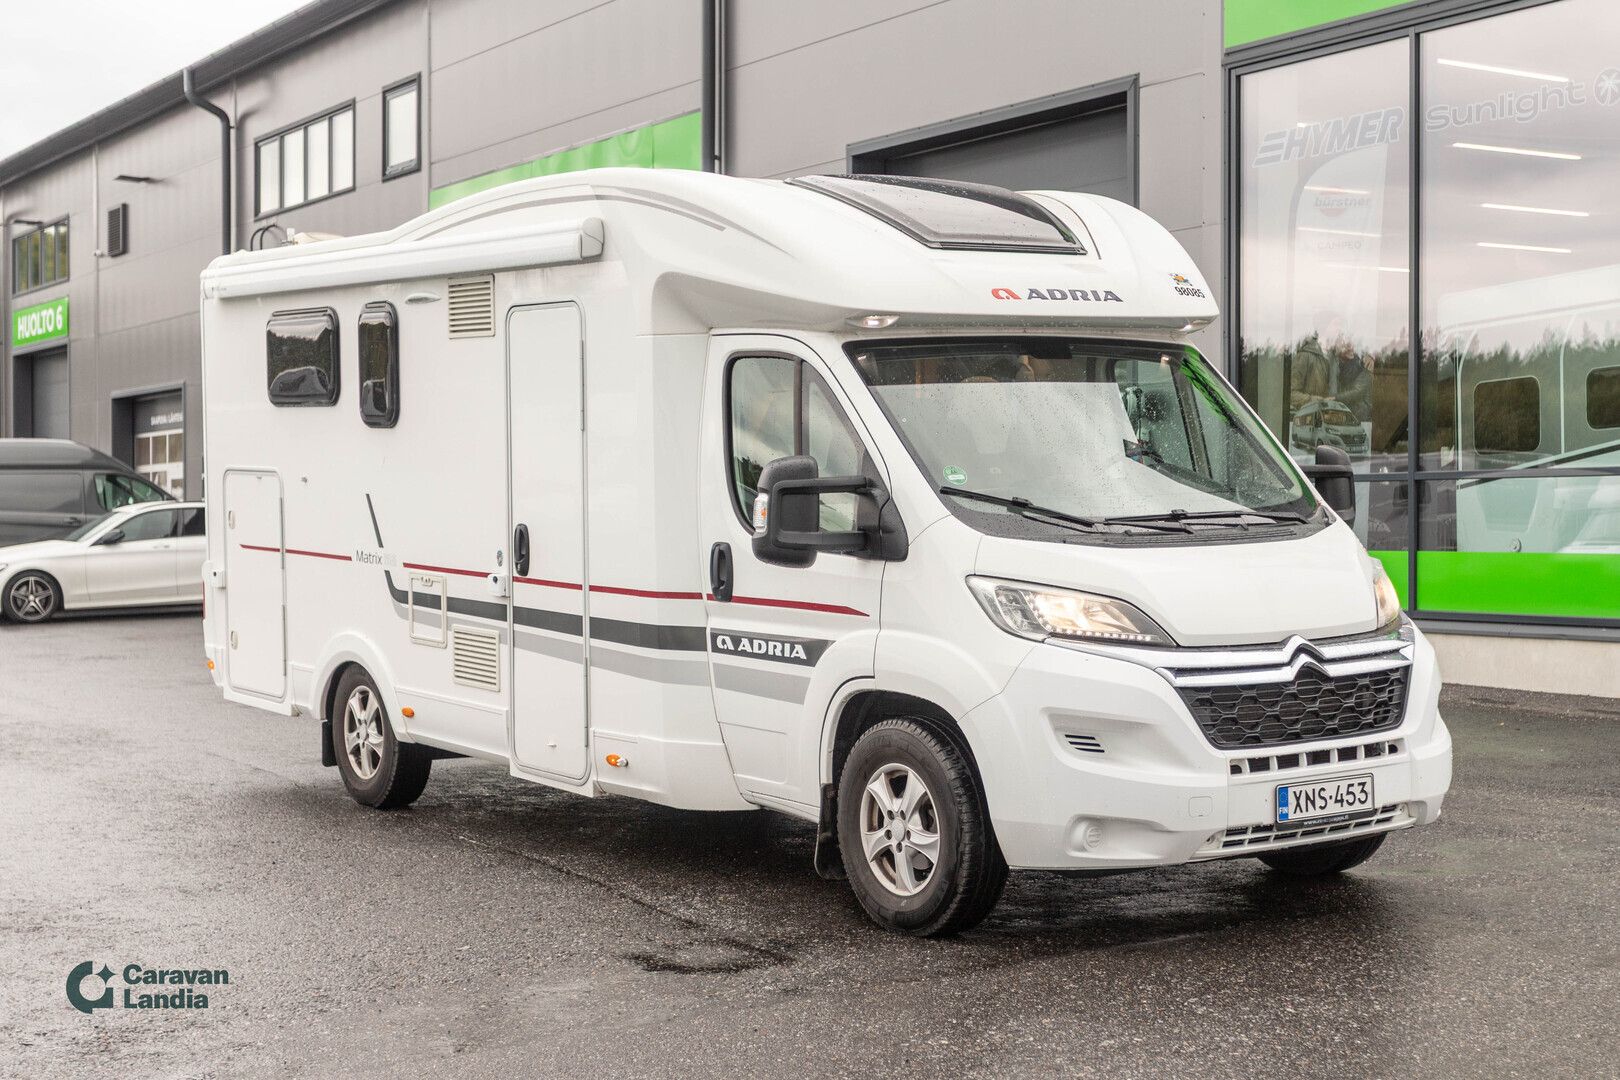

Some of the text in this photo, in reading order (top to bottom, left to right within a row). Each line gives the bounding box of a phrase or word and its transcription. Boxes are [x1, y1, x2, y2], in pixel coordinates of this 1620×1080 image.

[1425, 80, 1586, 132] Sunlight
[1278, 107, 1404, 161] HYMER
[1027, 288, 1124, 303] ADRIA
[1174, 286, 1205, 299] 98085
[17, 304, 63, 340] HUOLTO 6
[355, 549, 383, 566] Matrix
[737, 637, 807, 660] ADRIA
